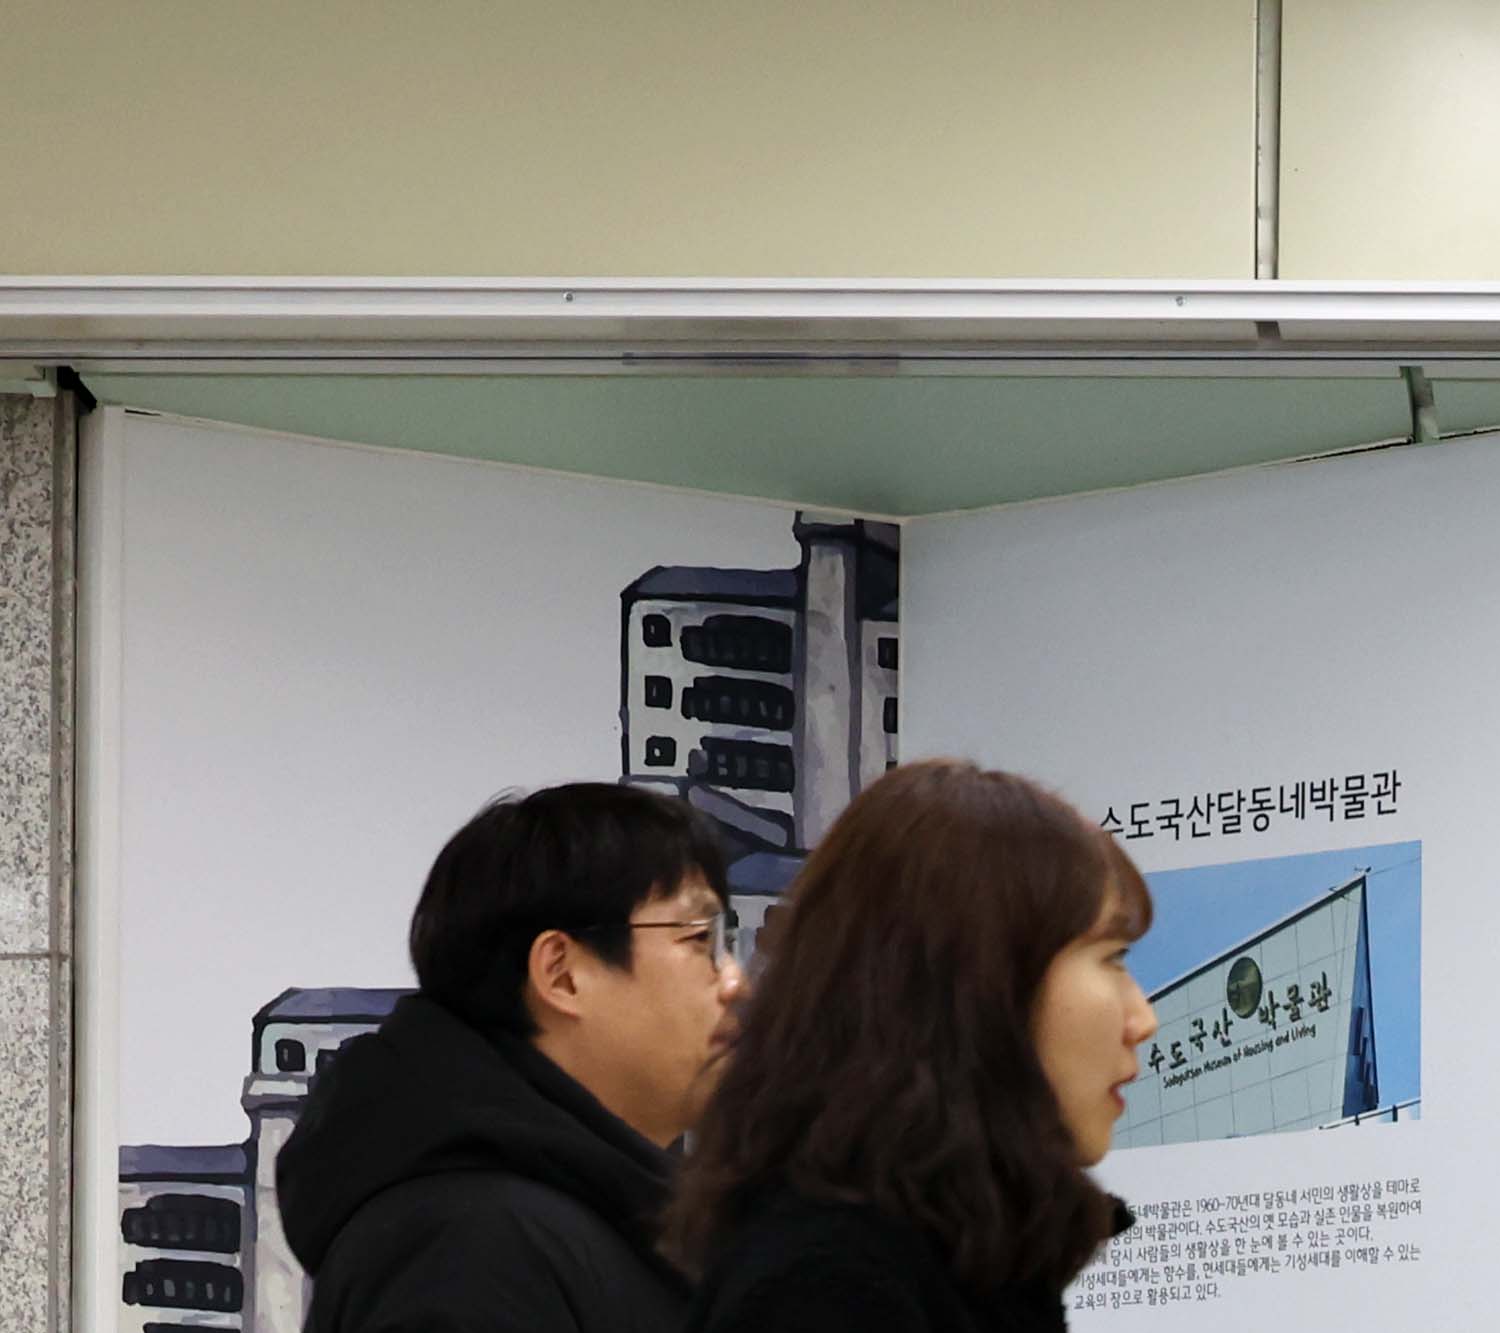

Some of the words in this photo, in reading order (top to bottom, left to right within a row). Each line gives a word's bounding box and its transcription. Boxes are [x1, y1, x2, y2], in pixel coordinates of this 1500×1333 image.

[1258, 971, 1333, 1030] 박물관
[1145, 1220, 1202, 1243] 박물관이다.
[1205, 1214, 1260, 1235] 수도국산의
[1263, 1213, 1274, 1231] 옛
[1277, 1209, 1311, 1229] 모습과
[1314, 1207, 1336, 1227] 실존
[1339, 1203, 1373, 1225] 인물을
[1376, 1199, 1421, 1220] 복원하여
[1074, 1291, 1107, 1311] 교육의
[1110, 1289, 1143, 1310] 장으로
[1147, 1284, 1192, 1307] 활용되고
[1195, 1282, 1221, 1302] 있다.
